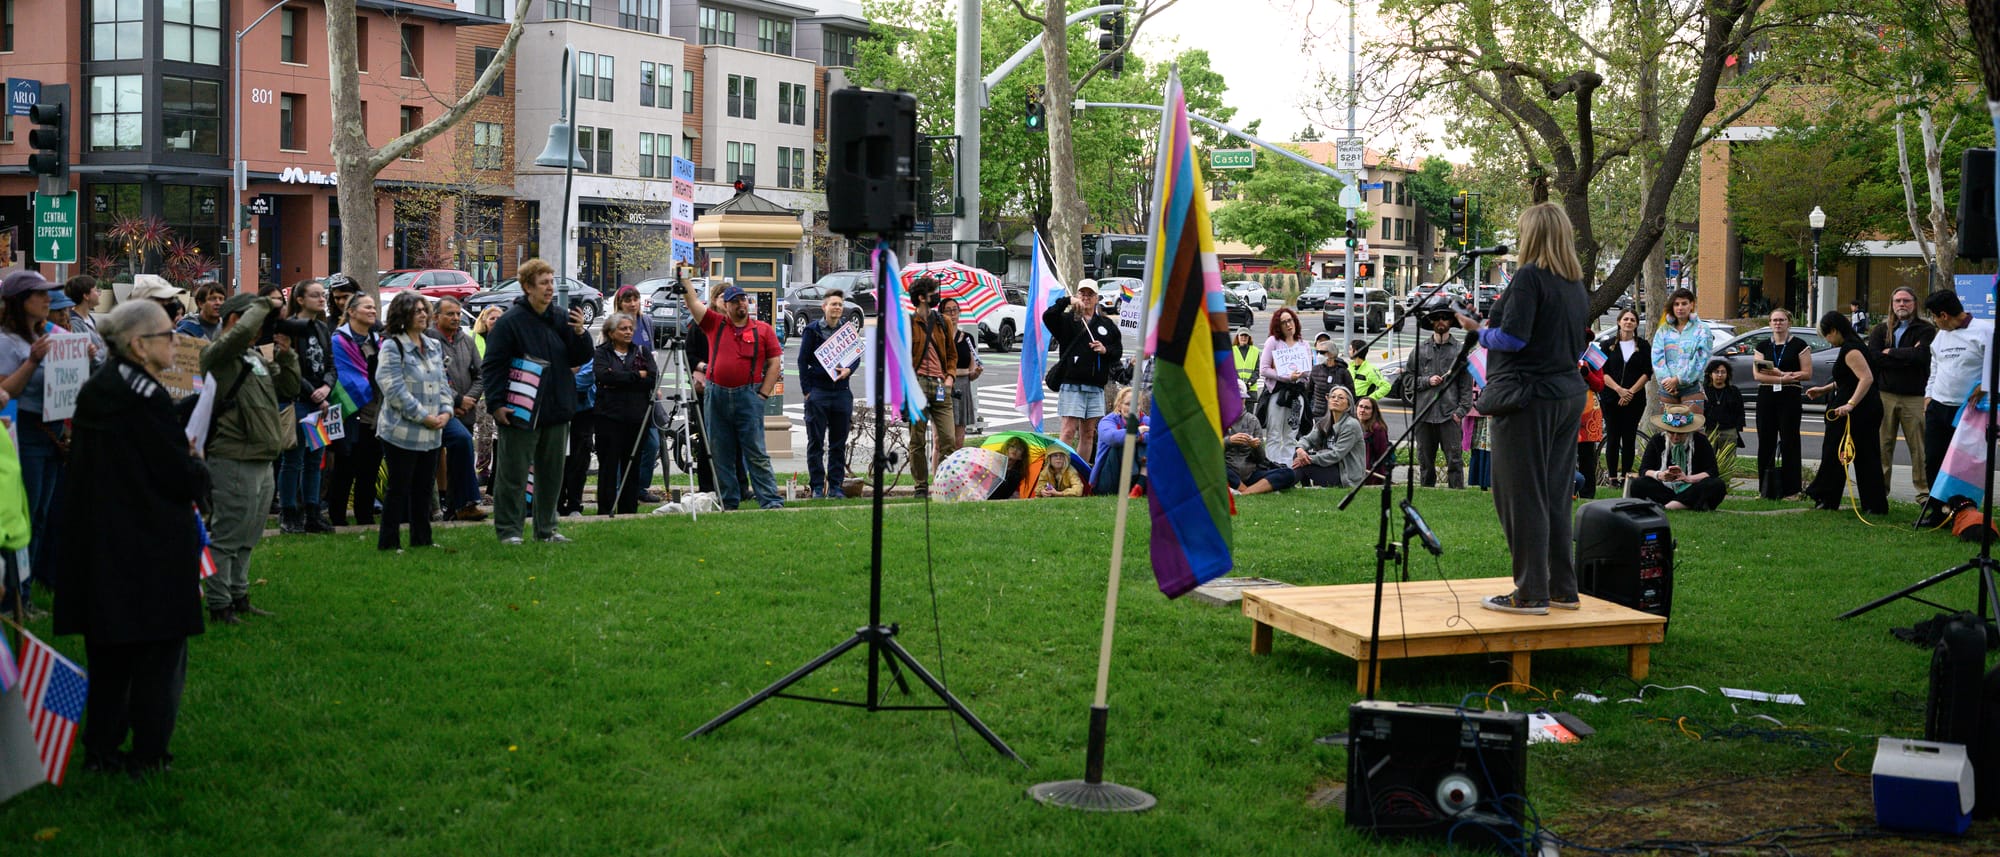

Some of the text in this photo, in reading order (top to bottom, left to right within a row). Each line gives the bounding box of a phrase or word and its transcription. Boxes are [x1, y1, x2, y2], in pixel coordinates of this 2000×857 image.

[13, 91, 36, 104] ARLO
[252, 88, 273, 104] 801
[1214, 155, 1250, 163] Castro
[676, 160, 692, 178] TRANS
[675, 180, 692, 199] RIGHTS
[51, 197, 60, 208] NB
[679, 203, 688, 218] ARE
[43, 212, 68, 223] CENTRAL
[629, 213, 646, 224] ROSE
[38, 226, 73, 238] EXPRESSWAY
[675, 222, 692, 239] HUMAN
[675, 243, 692, 260] RIGHTS
[1120, 310, 1140, 320] QUE
[1120, 319, 1139, 329] BRIC
[818, 326, 853, 359] YOU ARE
[822, 333, 857, 366] BELOVED
[1277, 353, 1306, 364] TRANS
[54, 367, 80, 385] TRANS
[330, 408, 340, 421] IS
